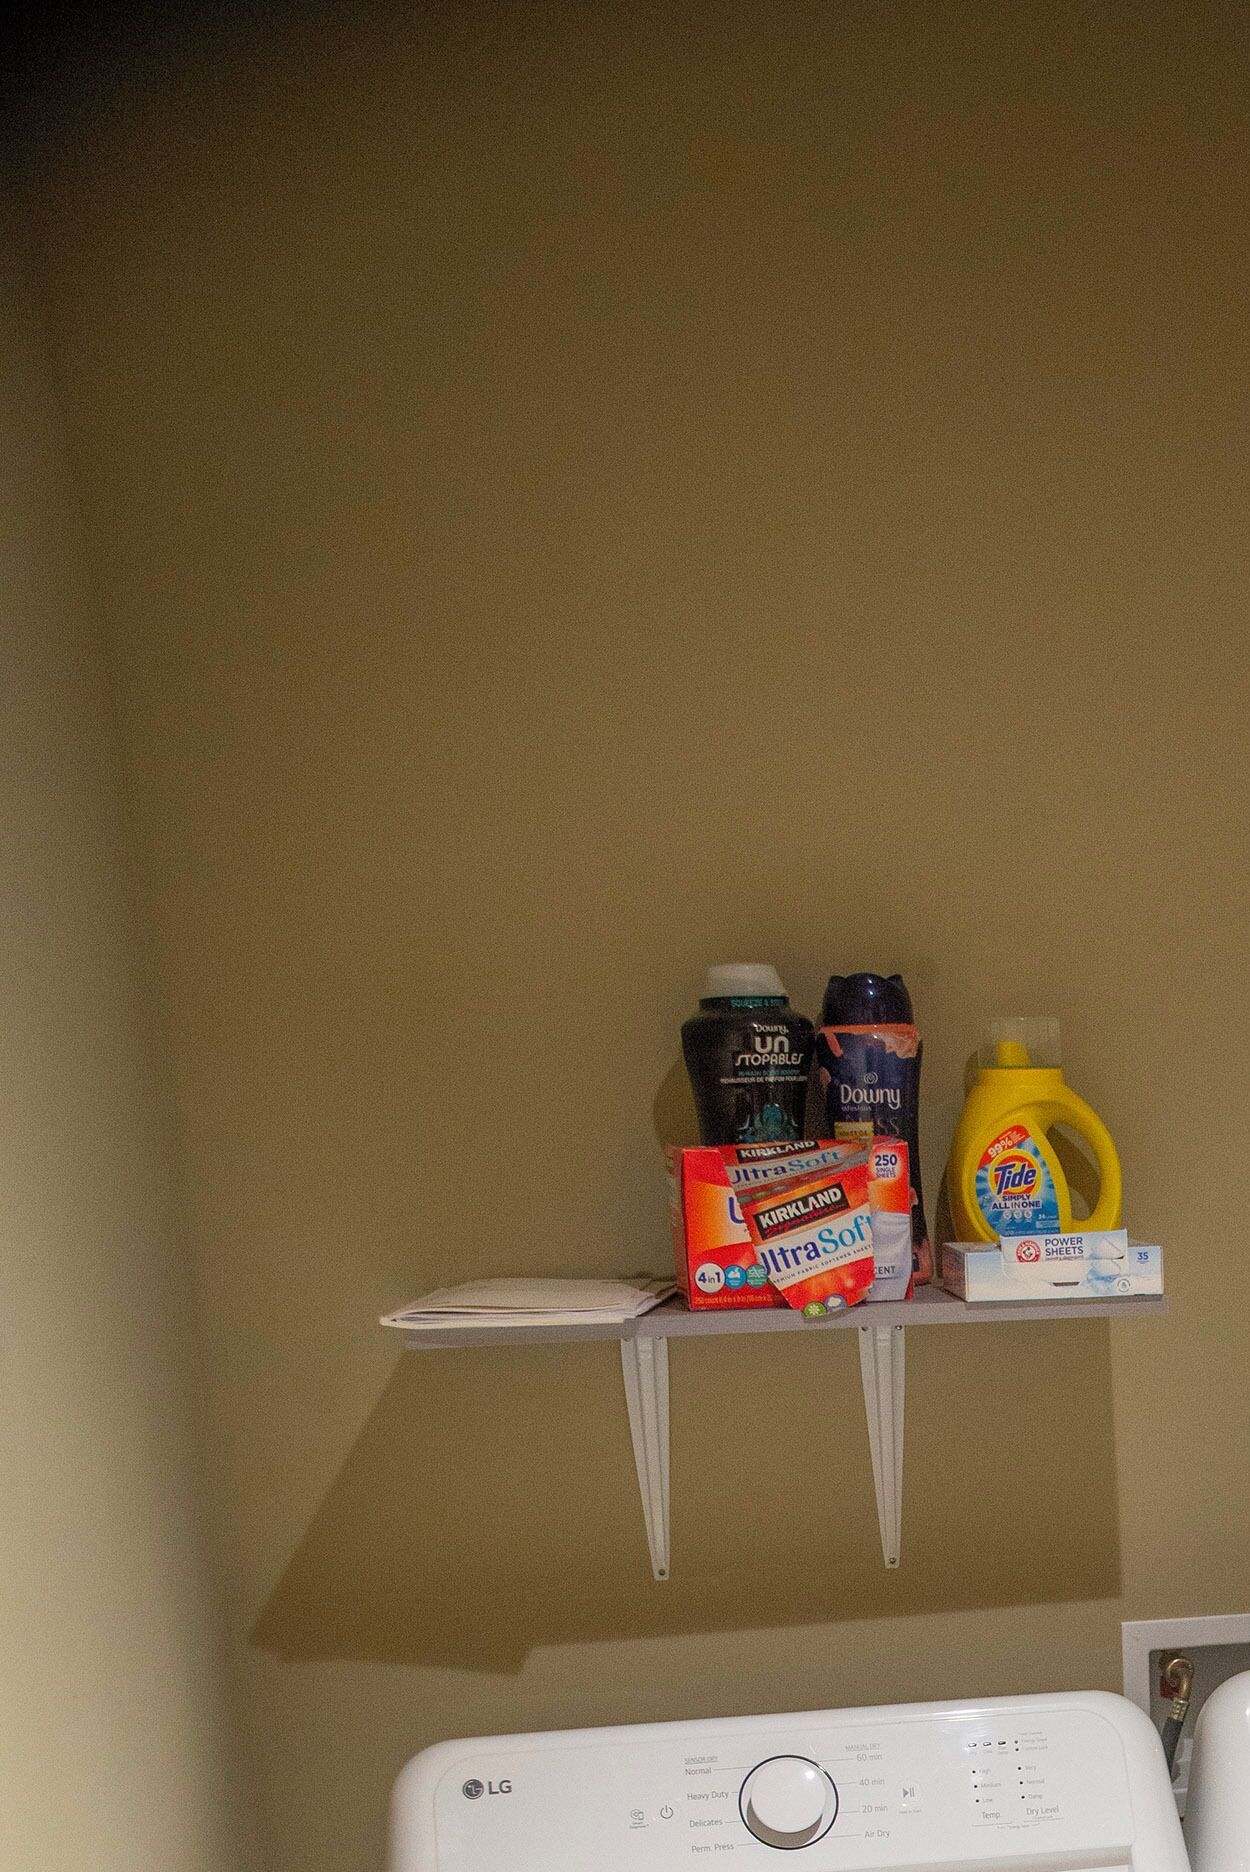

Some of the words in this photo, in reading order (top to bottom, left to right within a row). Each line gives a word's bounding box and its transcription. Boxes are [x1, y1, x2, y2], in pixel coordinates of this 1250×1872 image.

[841, 1084, 901, 1110] Downy
[740, 1141, 815, 1159] KIRKLAND
[988, 1137, 1013, 1158] 99%
[874, 1153, 898, 1167] 250
[994, 1163, 1036, 1195] Tide
[759, 1188, 843, 1229] KIRKLAND
[992, 1201, 1010, 1210] ALL
[1021, 1200, 1041, 1208] ONE
[1045, 1237, 1083, 1247] POWER
[1045, 1246, 1084, 1256] SHEETS
[1137, 1252, 1149, 1260] 35
[685, 1767, 712, 1776] Normal
[859, 1778, 869, 1786] 40
[488, 1780, 513, 1795] LG
[687, 1793, 709, 1801] Heavy
[711, 1790, 729, 1799] Duty
[862, 1804, 873, 1813] 20
[874, 1804, 888, 1812] min
[1026, 1807, 1039, 1816] Dry
[1040, 1805, 1059, 1814] Level
[982, 1811, 1001, 1819] Temp
[689, 1819, 723, 1828] Delicates
[877, 1829, 890, 1838] Dry
[714, 1843, 734, 1851] Press
